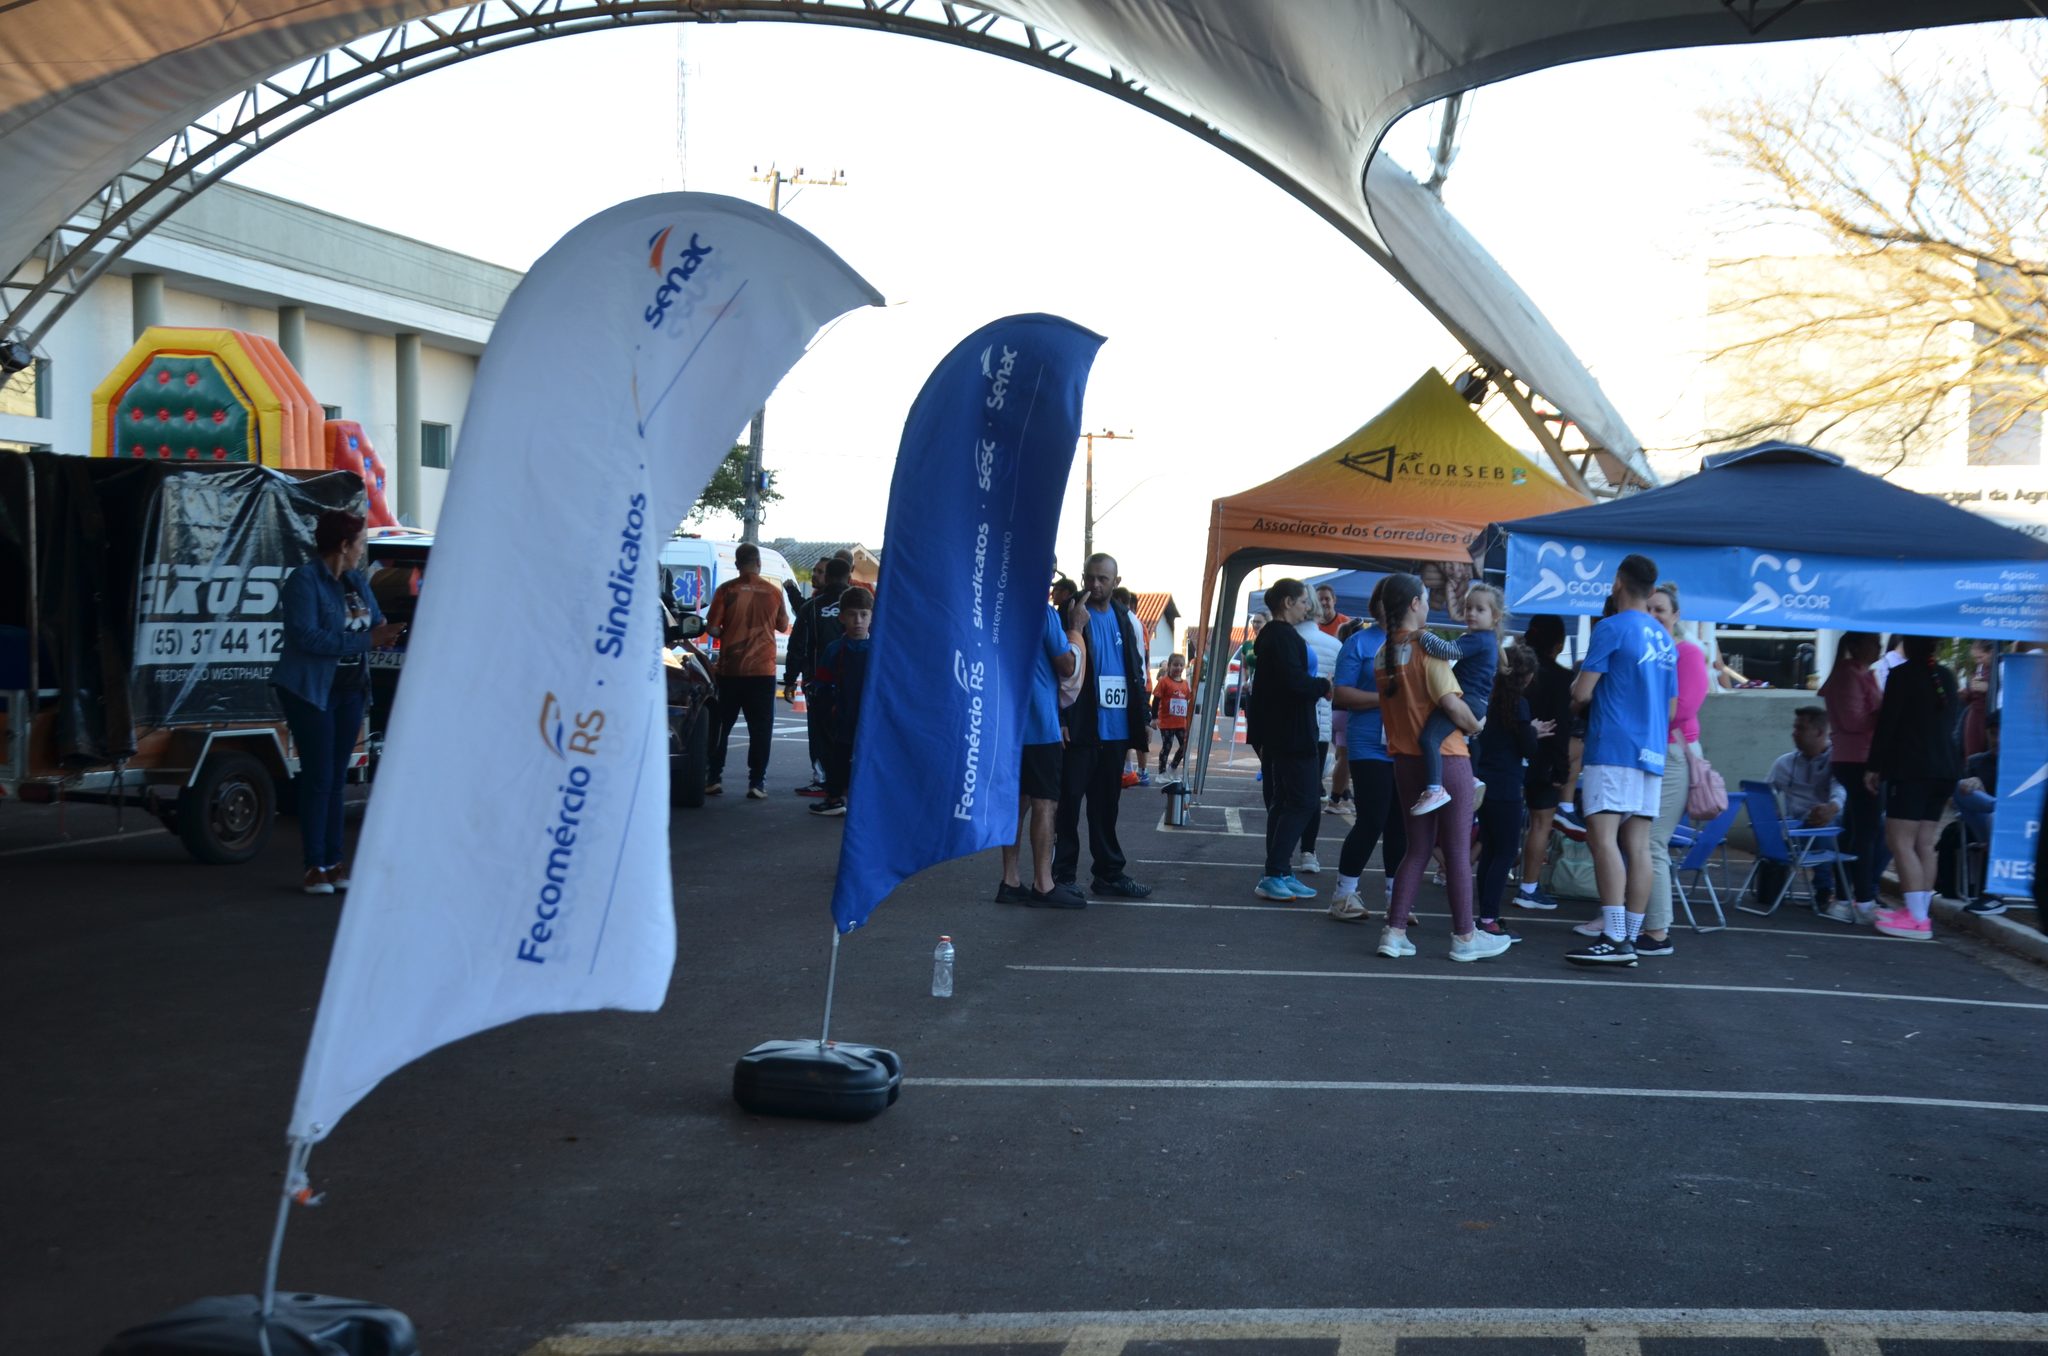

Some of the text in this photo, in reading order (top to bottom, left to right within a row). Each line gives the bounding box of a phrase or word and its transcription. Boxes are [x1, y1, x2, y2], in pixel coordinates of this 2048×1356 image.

[1397, 461, 1506, 480] ACORSEB
[1253, 517, 1338, 537] Associação
[1342, 523, 1370, 538] dos
[1373, 526, 1457, 544] Corredores
[997, 531, 1013, 590] Comércio
[1782, 593, 1832, 609] GCOR
[1105, 688, 1127, 705] 667
[516, 765, 592, 965] Fecomércio
[567, 709, 605, 756] RS
[595, 492, 648, 659] Sindicatos
[953, 696, 984, 821] Fecomércio
[969, 661, 985, 691] RS
